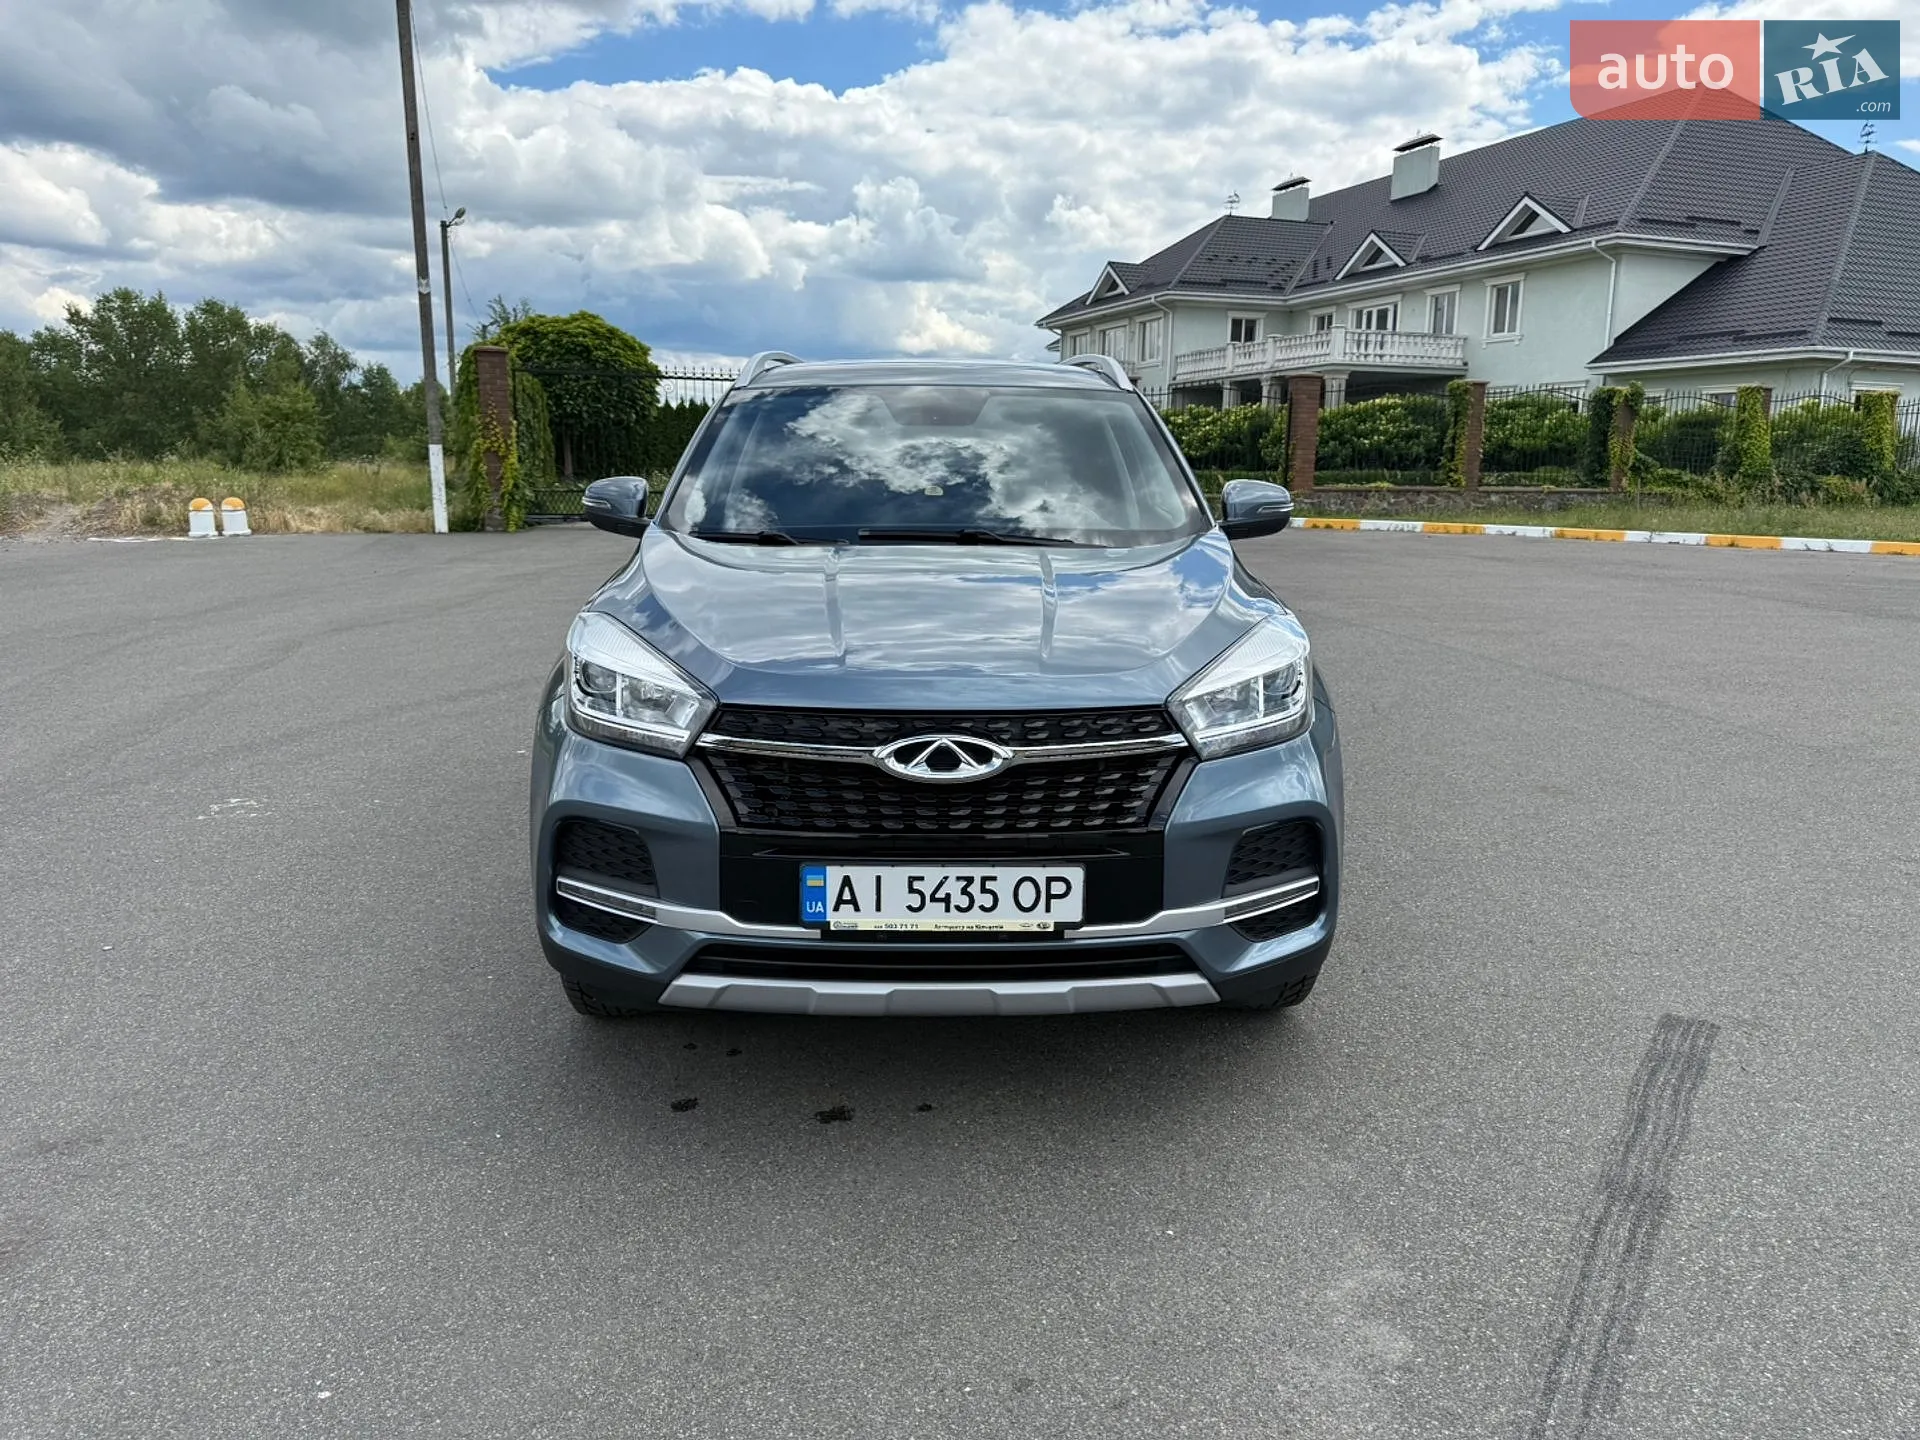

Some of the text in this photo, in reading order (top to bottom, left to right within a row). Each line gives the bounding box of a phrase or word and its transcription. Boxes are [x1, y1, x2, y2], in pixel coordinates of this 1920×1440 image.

[832, 875, 1072, 913] AI 5435 OP
[806, 902, 824, 913] UA
